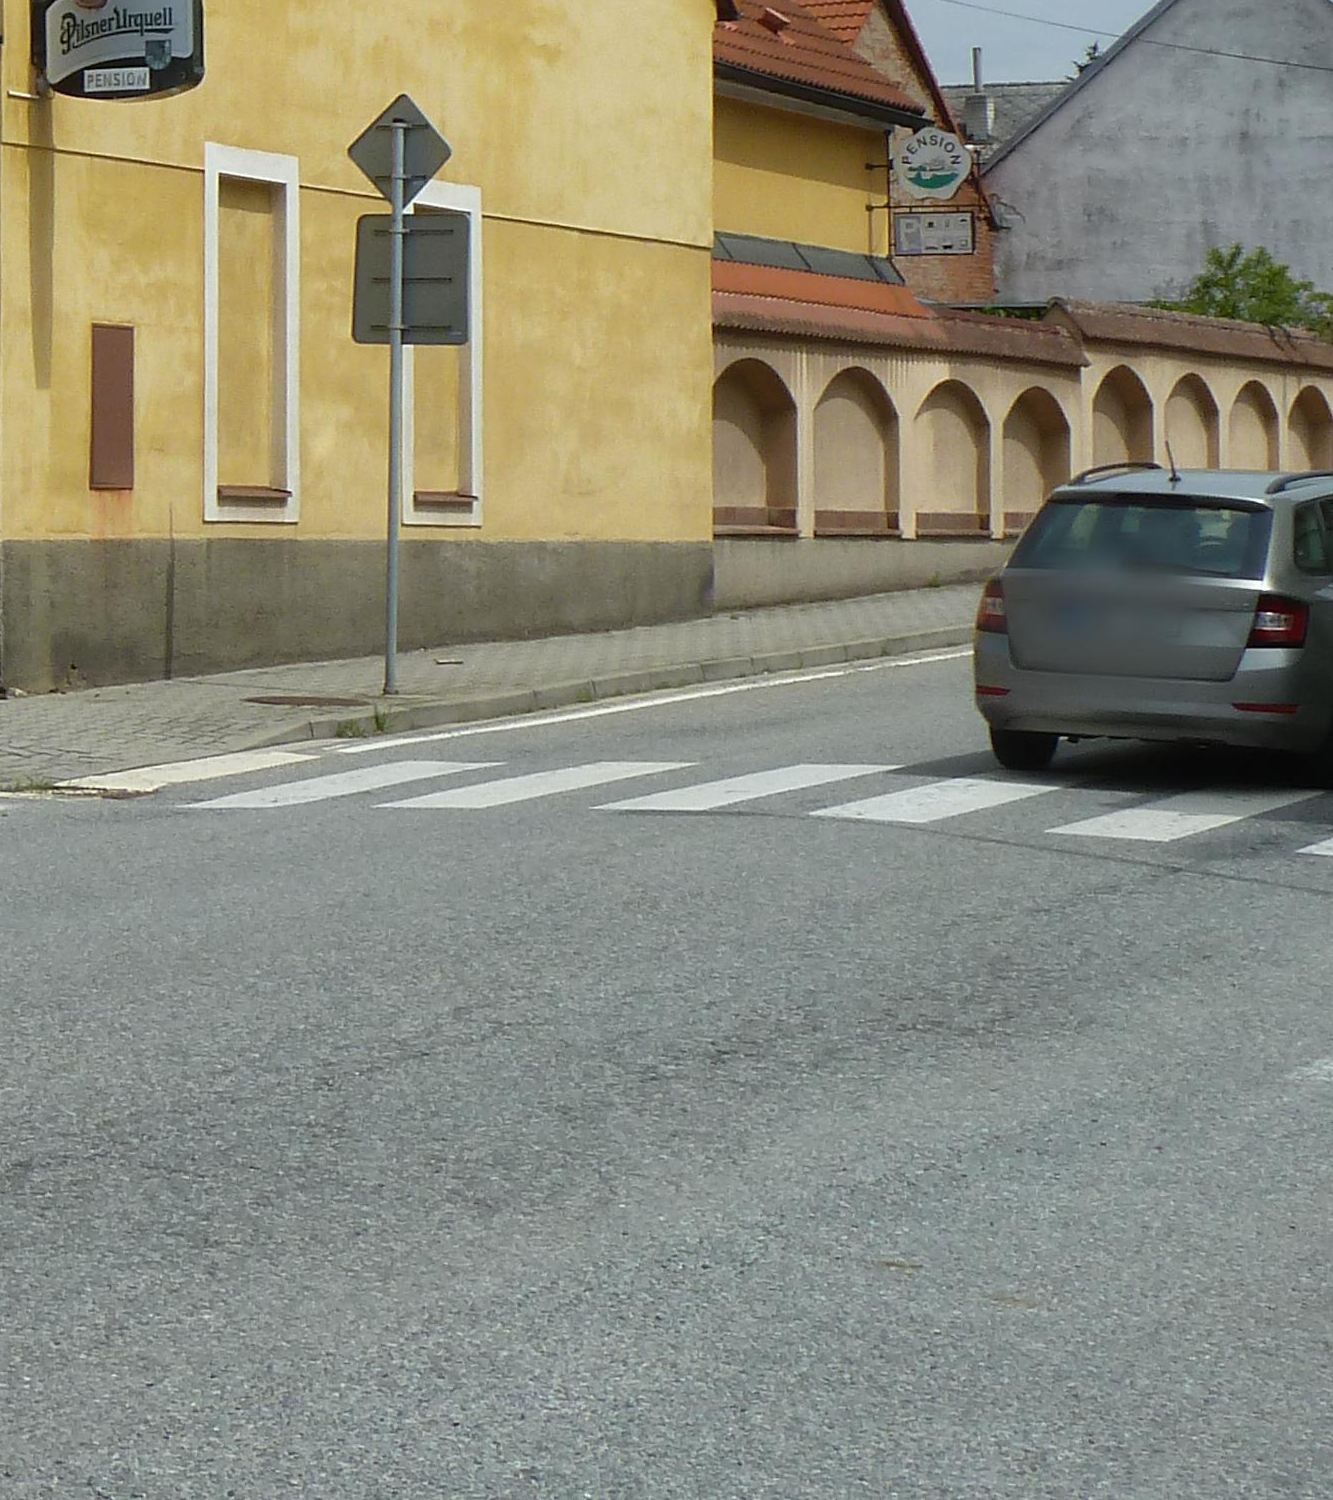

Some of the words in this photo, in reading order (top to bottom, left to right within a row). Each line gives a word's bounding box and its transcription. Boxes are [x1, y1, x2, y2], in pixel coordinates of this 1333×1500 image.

[60, 11, 115, 56] Pilsner
[113, 6, 174, 37] Urquell
[86, 72, 148, 89] PENSION
[901, 134, 962, 166] PENSION
